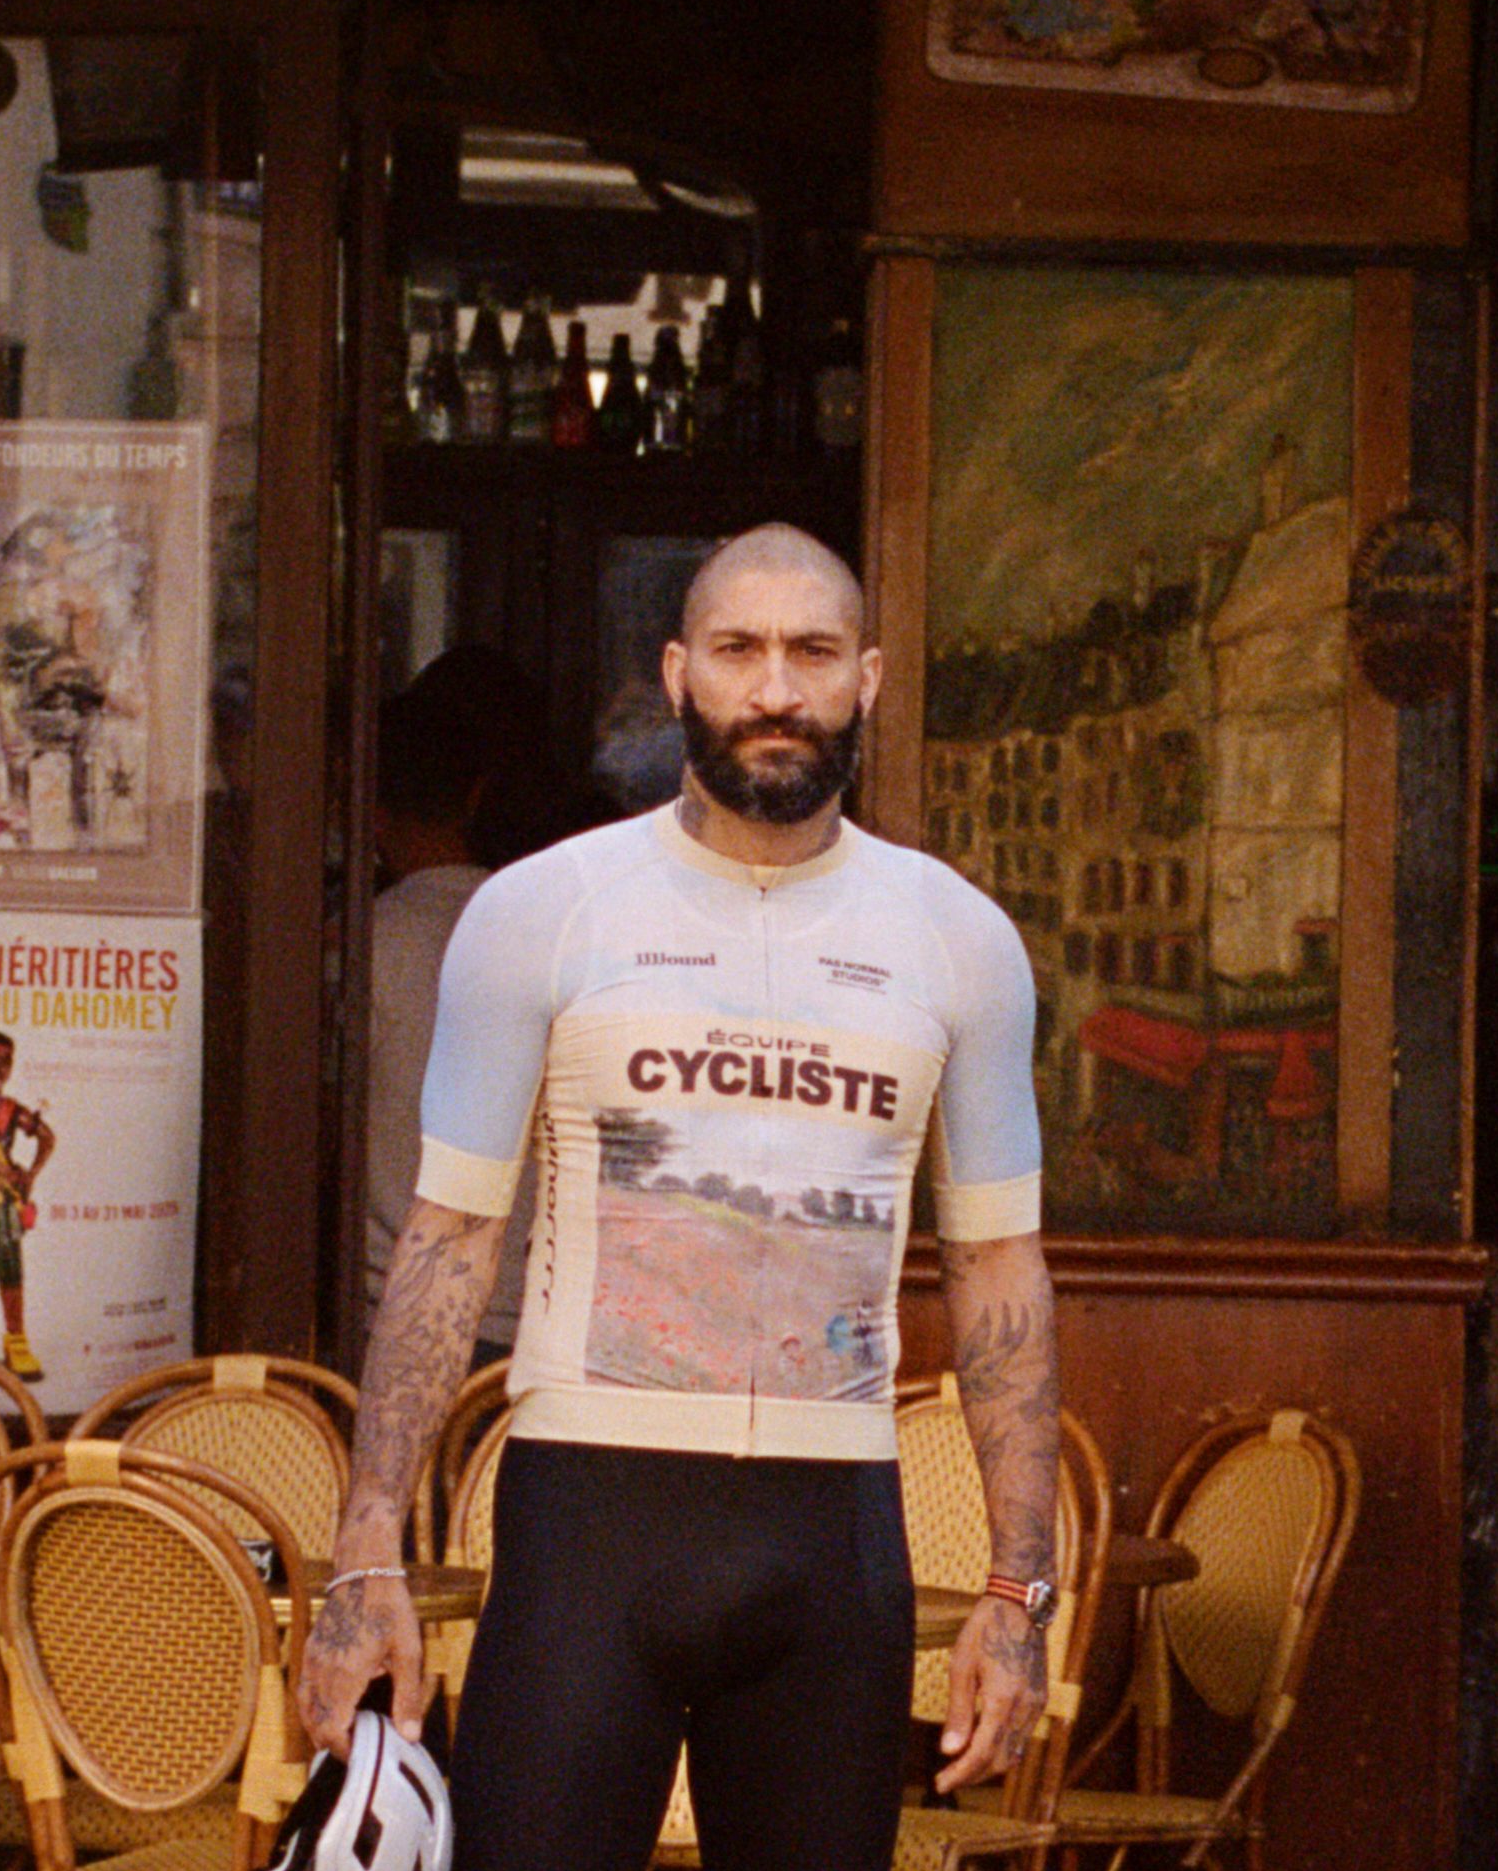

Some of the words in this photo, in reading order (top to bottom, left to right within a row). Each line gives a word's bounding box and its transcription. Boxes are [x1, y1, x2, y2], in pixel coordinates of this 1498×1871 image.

[125, 443, 188, 470] TEMPS
[31, 989, 178, 1032] DAHOMEY
[706, 1028, 832, 1058] ÉQUIPE
[626, 1048, 899, 1122] CYCLISTE
